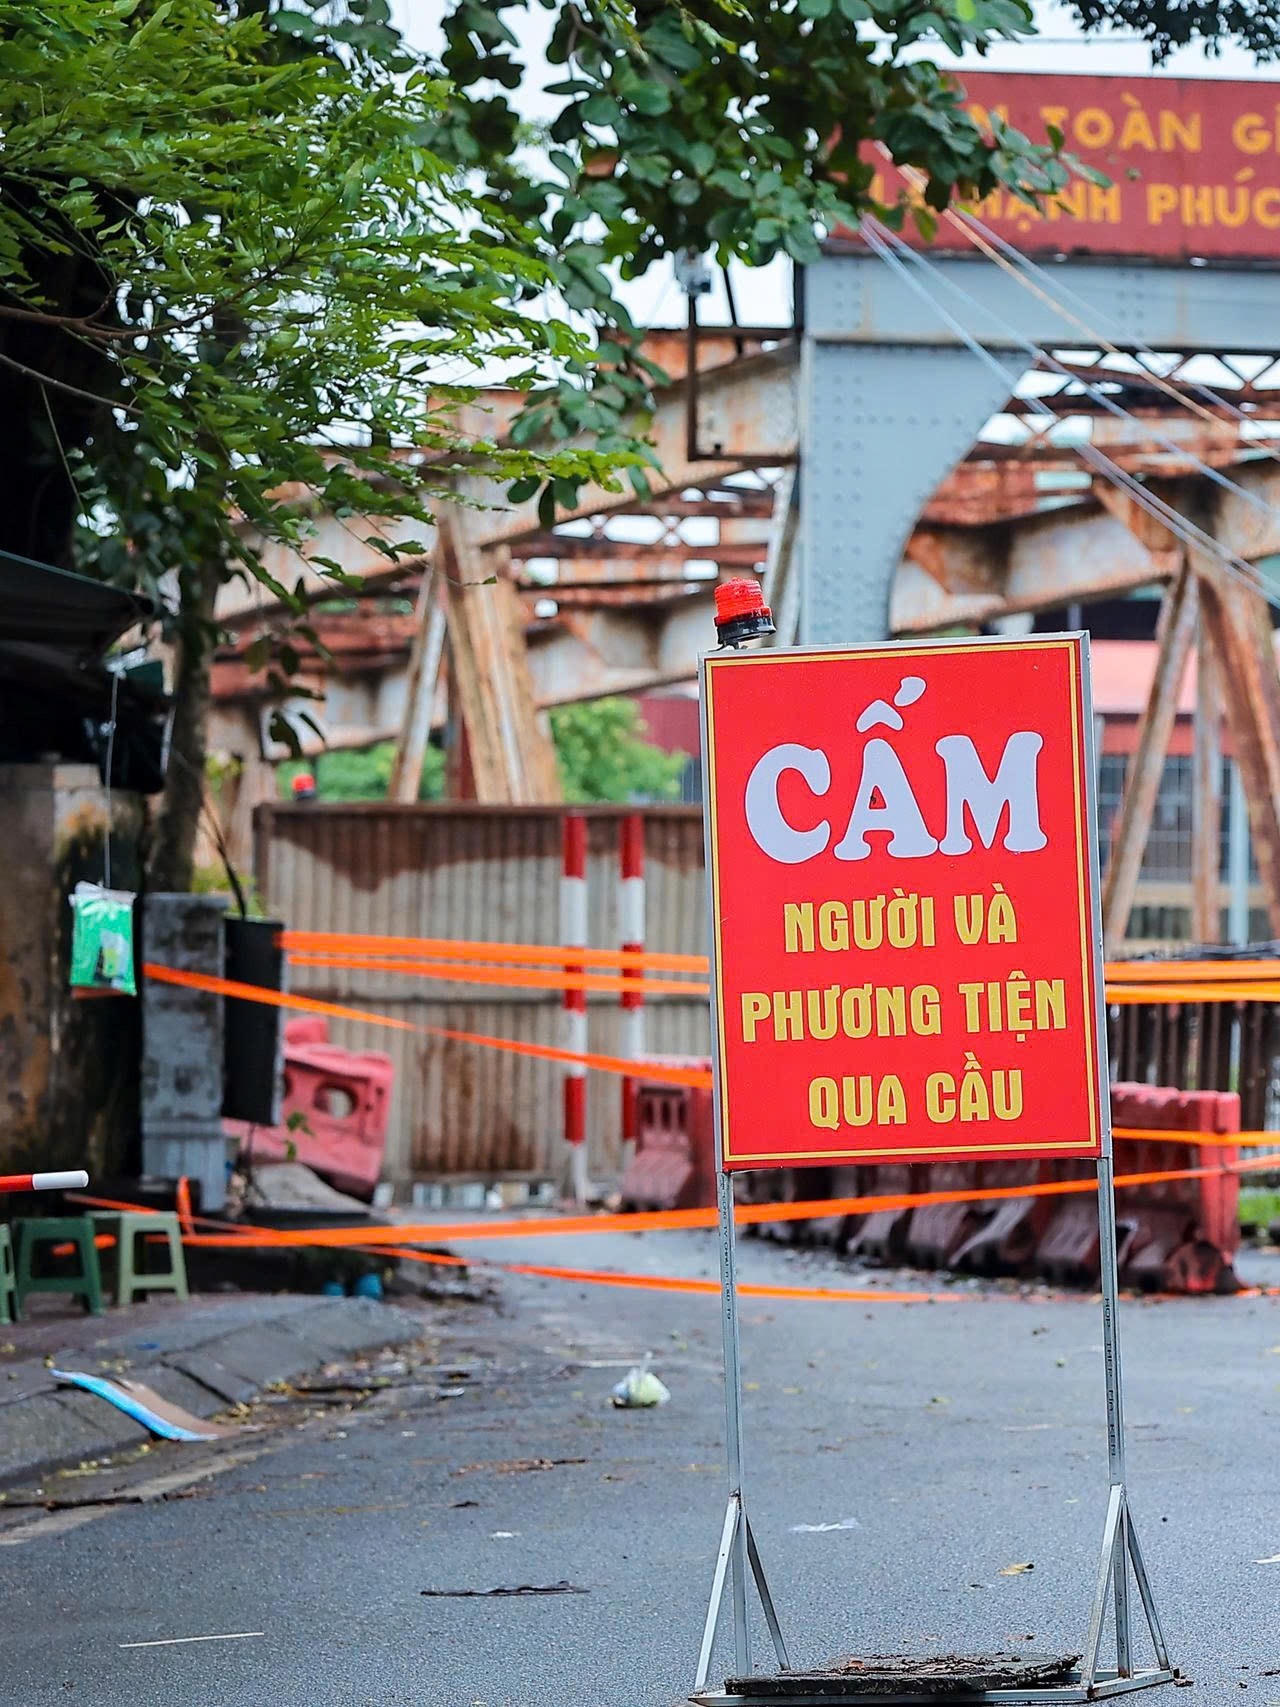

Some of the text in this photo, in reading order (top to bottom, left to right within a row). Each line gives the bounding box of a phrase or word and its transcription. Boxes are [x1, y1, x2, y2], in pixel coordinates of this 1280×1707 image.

[1039, 91, 1203, 153] TOÀN
[744, 675, 1050, 867] CẤM
[784, 882, 1018, 955] NGƯỜI VÀ
[741, 970, 1068, 1044] PHƯƠNG TIỆN
[808, 1052, 1024, 1130] QUA CẦU
